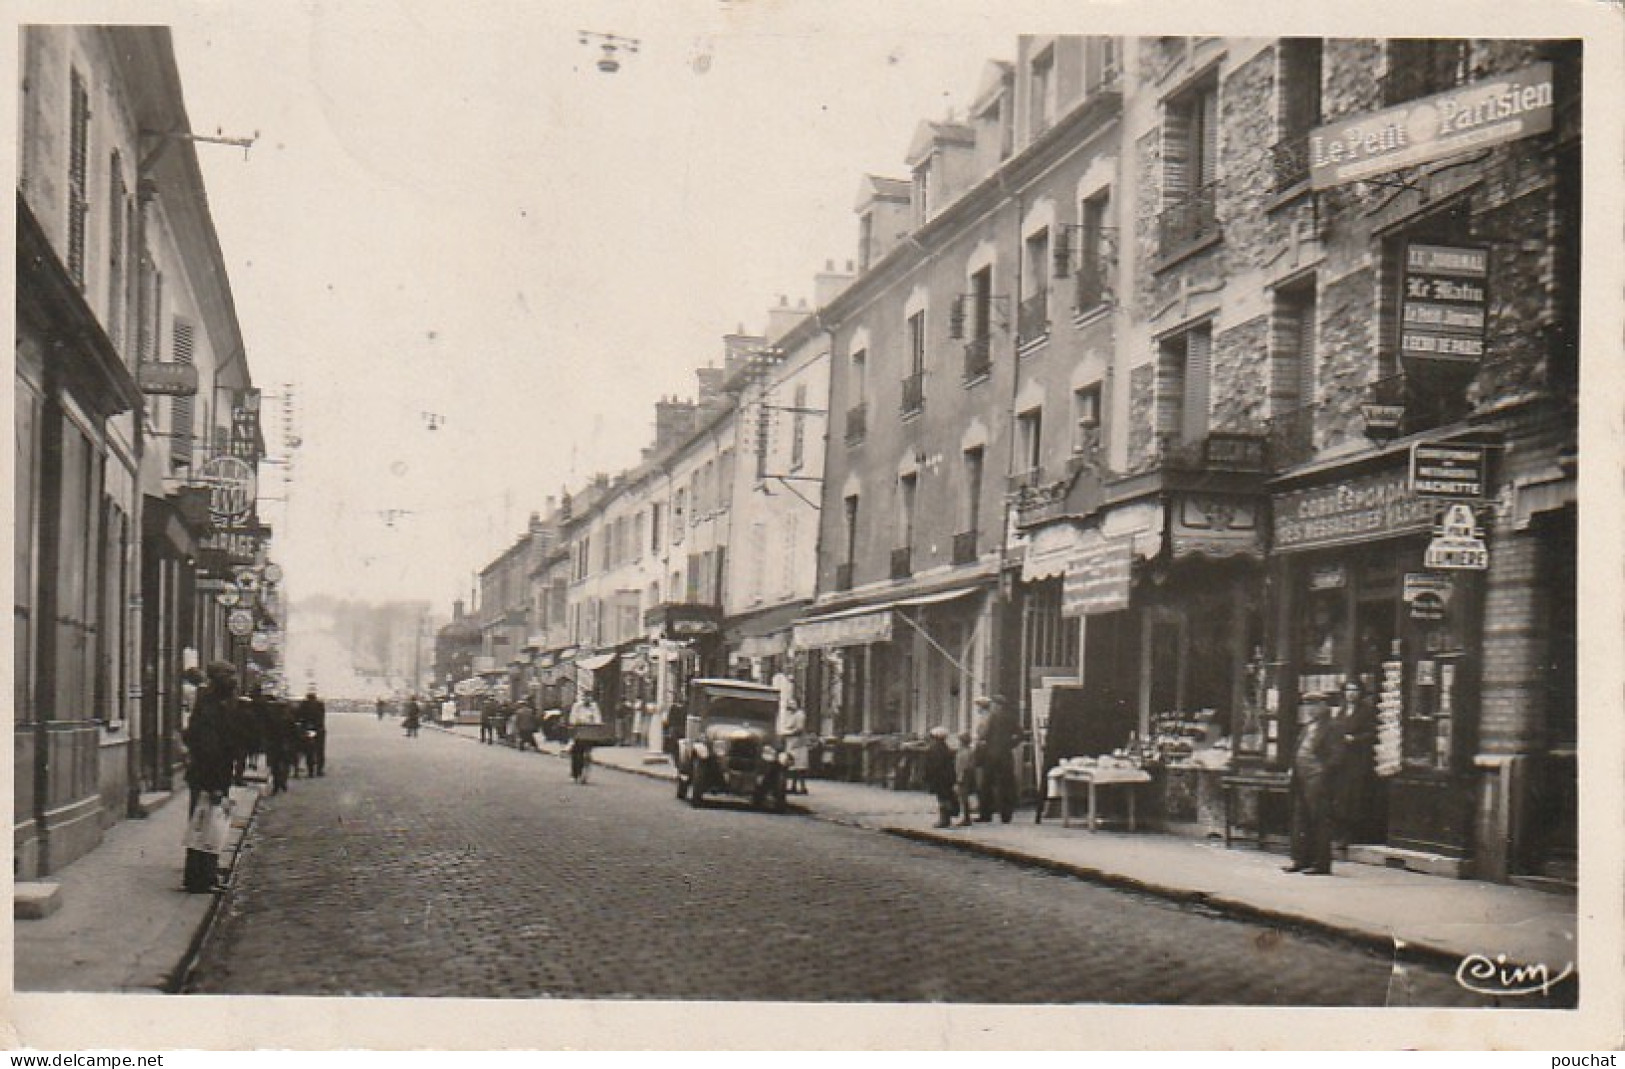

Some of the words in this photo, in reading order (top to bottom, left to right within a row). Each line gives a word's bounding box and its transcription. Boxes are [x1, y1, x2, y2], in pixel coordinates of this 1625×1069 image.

[1312, 136, 1344, 168] Le
[1345, 118, 1408, 158] Petit
[1436, 81, 1553, 134] Parisien
